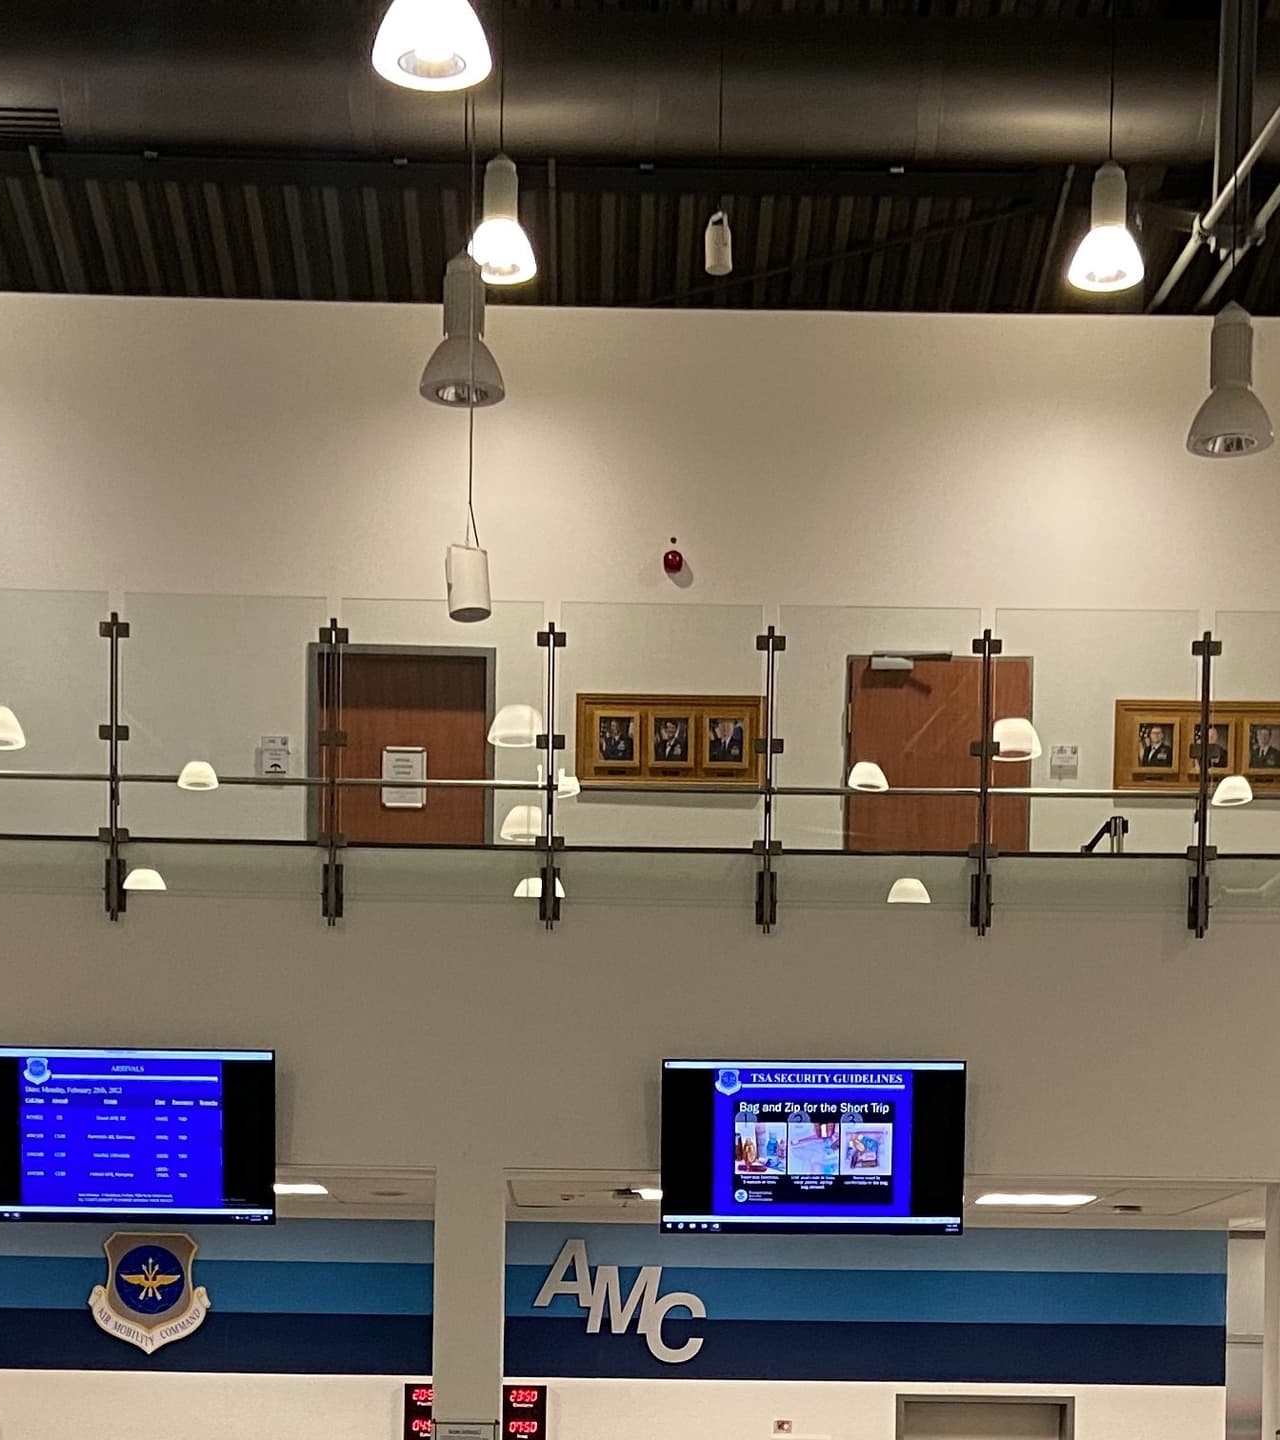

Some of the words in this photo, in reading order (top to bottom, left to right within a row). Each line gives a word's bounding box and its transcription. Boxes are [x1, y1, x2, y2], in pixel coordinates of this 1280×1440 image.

[111, 1065, 145, 1073] ARRIVALS
[750, 1073, 772, 1083] TSA
[774, 1073, 832, 1084] SECURITY
[833, 1073, 903, 1084] GUIDELINES
[739, 1102, 760, 1114] Bag
[762, 1102, 782, 1113] and
[784, 1102, 801, 1114] Zip
[803, 1102, 818, 1113] for
[820, 1102, 837, 1113] the
[840, 1102, 869, 1113] Short
[871, 1102, 890, 1115] Trip
[533, 1239, 707, 1364] AMC
[98, 1307, 112, 1326] AIR
[113, 1321, 155, 1347] MOBILITY
[159, 1308, 201, 1340] COMMAND
[509, 1390, 538, 1402] 23:50
[509, 1421, 538, 1433] 07:50
